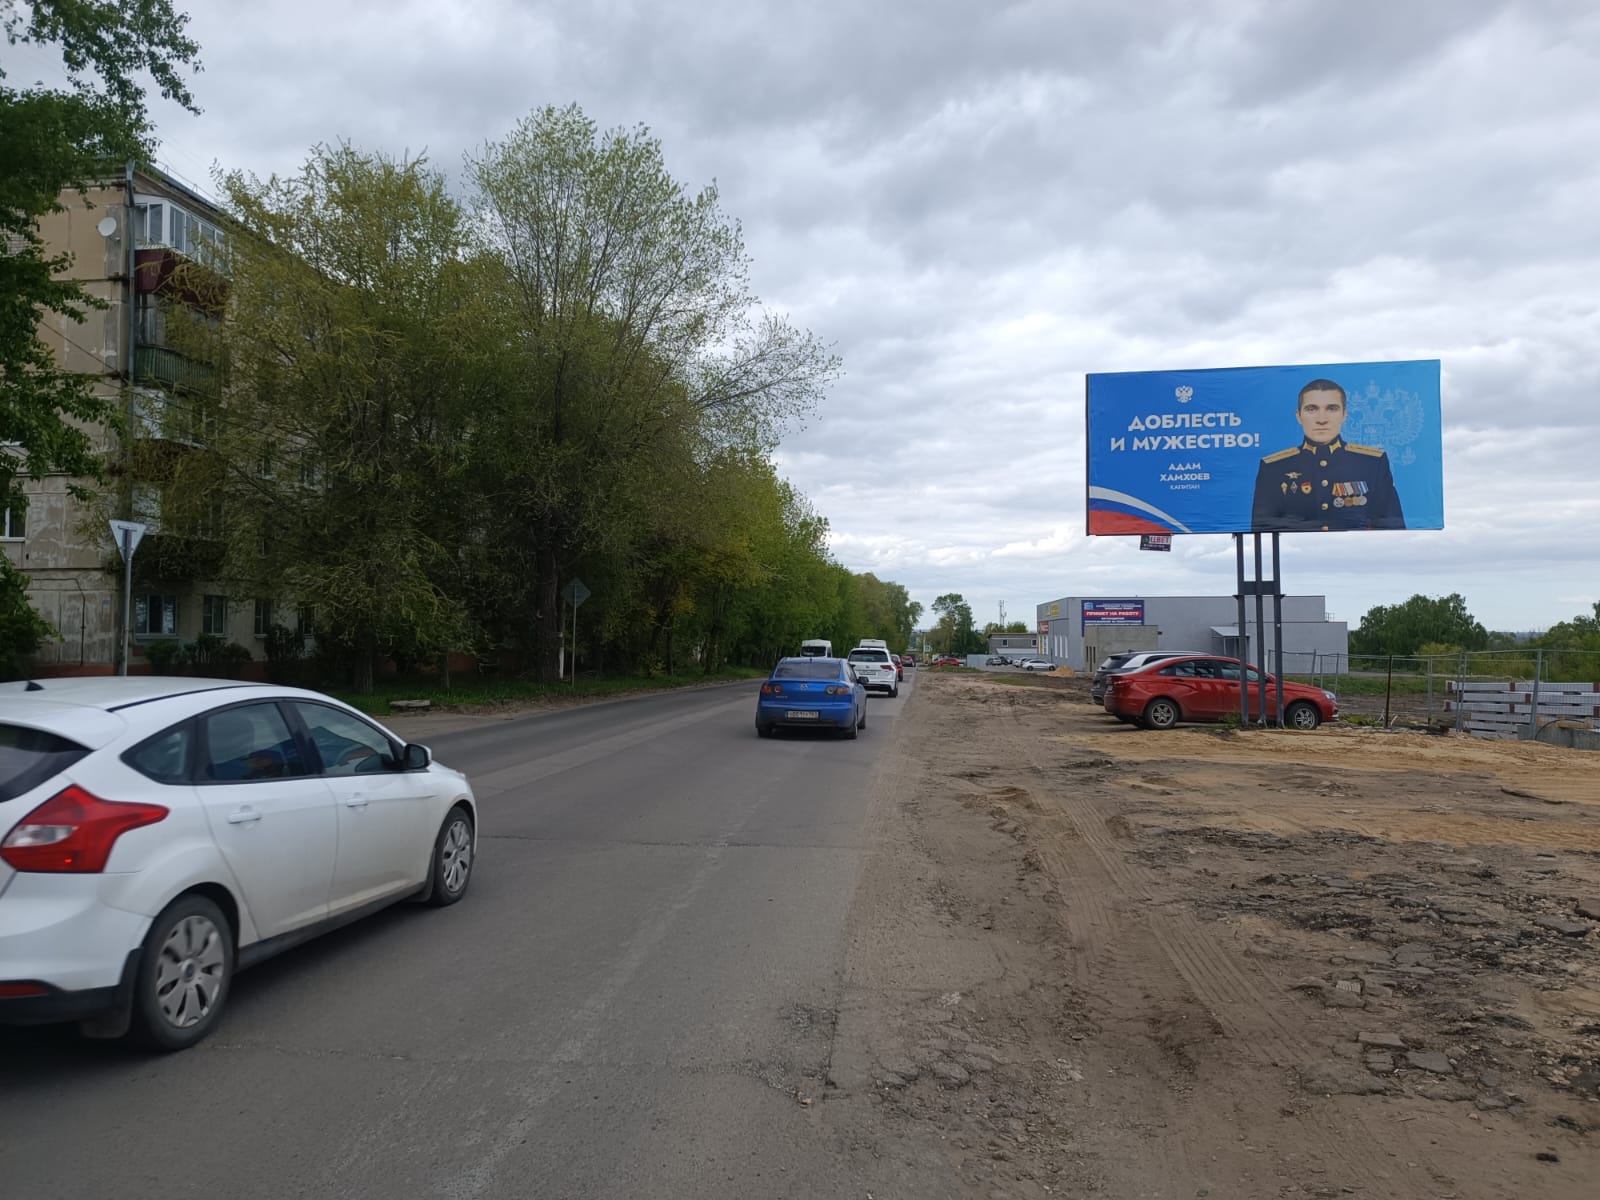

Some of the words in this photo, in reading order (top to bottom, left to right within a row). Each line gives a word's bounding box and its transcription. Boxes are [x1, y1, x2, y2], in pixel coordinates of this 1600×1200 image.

[1128, 413, 1242, 431] ДОБЛЕСТЬ
[1111, 437, 1125, 451] И
[1132, 433, 1260, 450] МУЖЕСТВО!
[1168, 462, 1201, 470] АДАМ
[1160, 473, 1210, 481] ХАМХОЕВ
